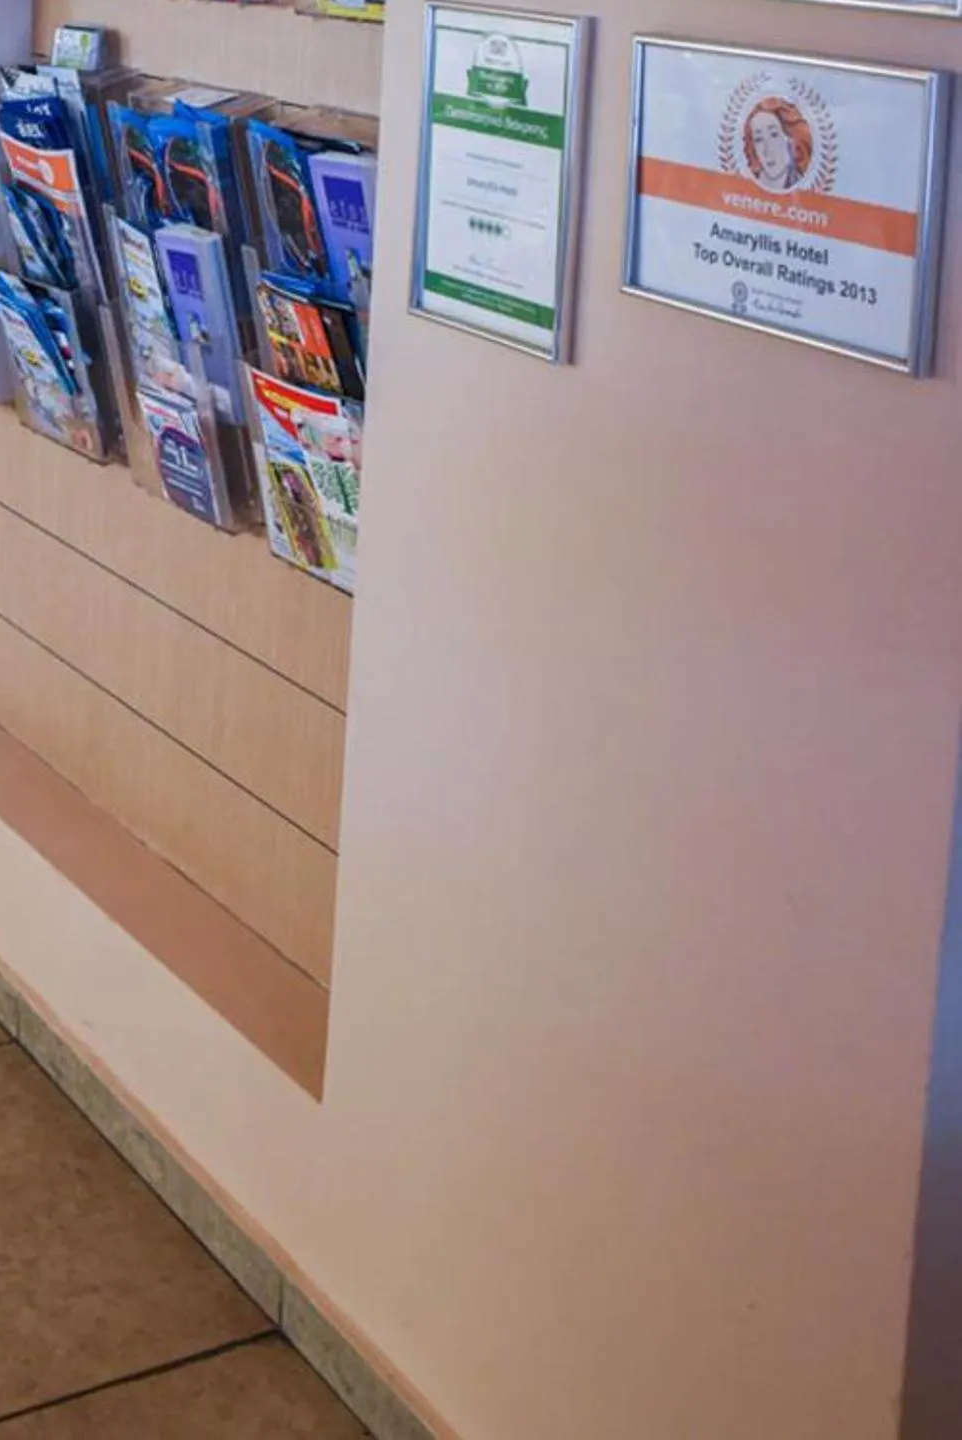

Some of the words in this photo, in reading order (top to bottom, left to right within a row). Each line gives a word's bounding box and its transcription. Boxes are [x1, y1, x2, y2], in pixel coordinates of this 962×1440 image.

[721, 190, 831, 228] venere.com
[709, 221, 783, 256] Amaryllis
[786, 241, 829, 266] Hotel
[692, 241, 720, 266] Top
[722, 250, 774, 279] Overall
[777, 263, 836, 296] Ratings
[839, 280, 879, 307] 2013
